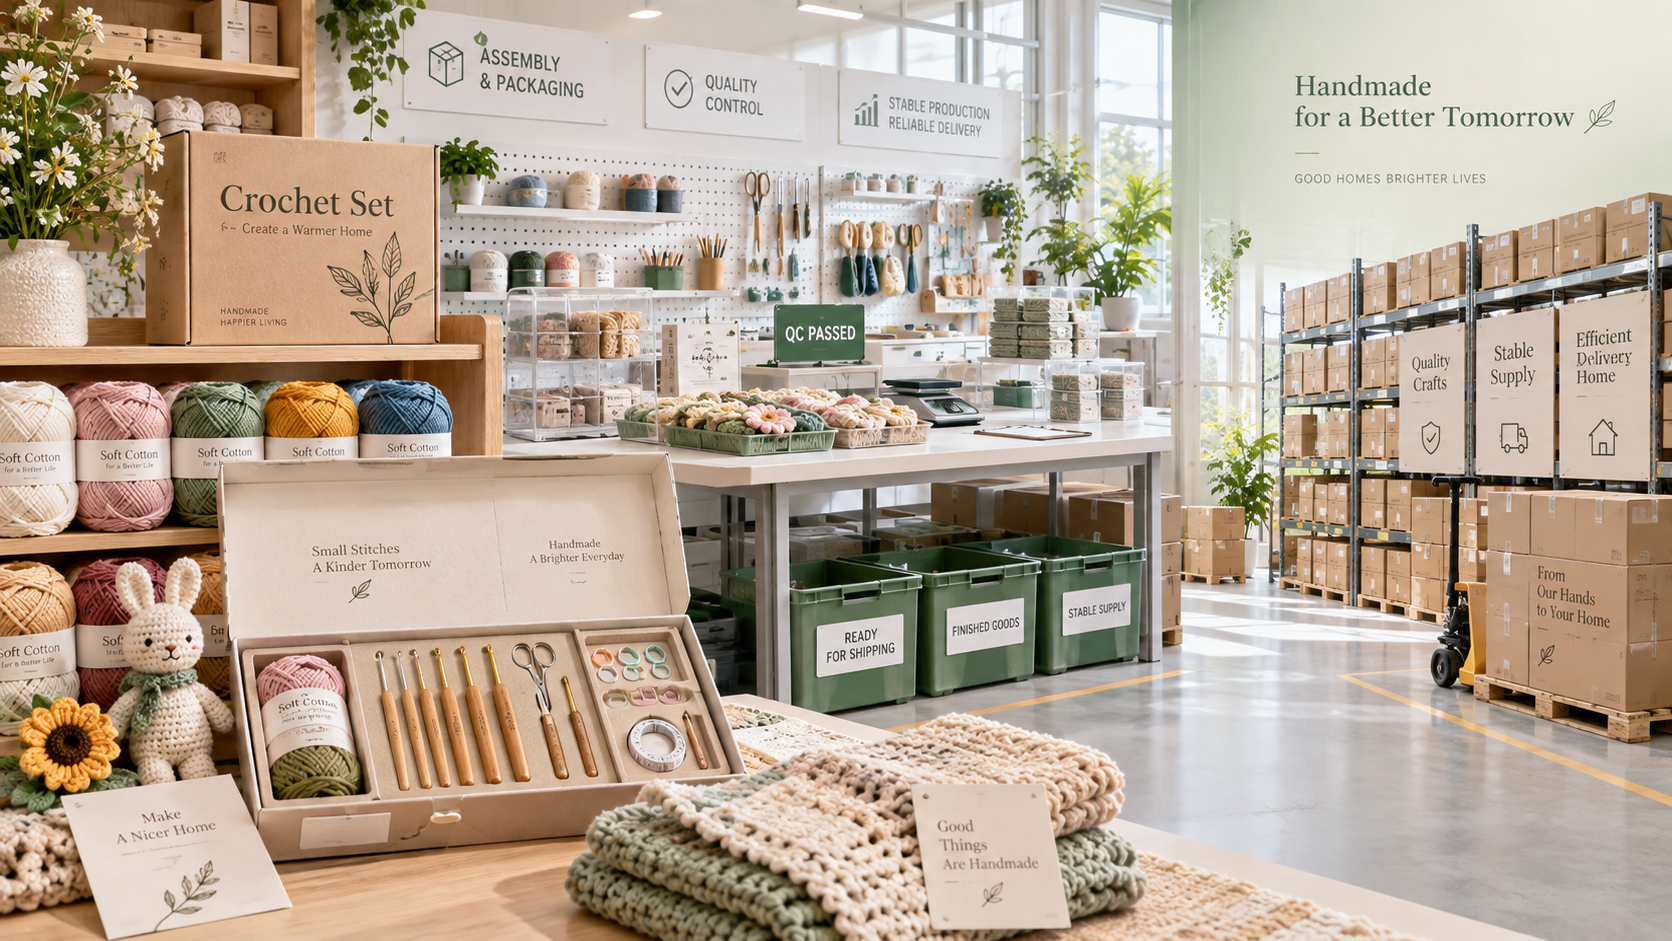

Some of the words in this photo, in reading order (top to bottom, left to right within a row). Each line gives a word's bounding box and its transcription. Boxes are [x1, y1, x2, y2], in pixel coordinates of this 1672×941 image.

[480, 48, 561, 72] ASSEMBLY
[480, 73, 491, 90] &
[497, 74, 584, 98] PACKAGING
[705, 74, 758, 94] QUALITY
[1295, 74, 1431, 97] Handmade
[705, 97, 764, 116] CONTROL
[888, 97, 926, 113] STABLE
[929, 100, 991, 121] PRODUCTION
[1295, 105, 1331, 127] for
[1338, 111, 1351, 127] a
[1360, 106, 1435, 127] Better
[1442, 106, 1575, 127] Tomorrow
[888, 116, 935, 133] RELIABLE
[938, 121, 982, 138] DELIVERY
[1294, 173, 1332, 184] GOOD
[1336, 173, 1381, 184] HOMES
[1386, 173, 1448, 184] BRIGHTER
[1453, 173, 1486, 184] LIVES
[220, 184, 341, 216] Crochet
[350, 190, 395, 217] Set
[242, 223, 279, 235] Create
[282, 226, 289, 235] a
[292, 224, 337, 237] Warmer
[340, 226, 373, 237] Home
[220, 307, 269, 316] HANDMADE
[220, 318, 257, 327] HAPPIER
[259, 318, 287, 327] LIVING
[785, 326, 804, 343] QC
[808, 325, 856, 341] PASSED
[1576, 328, 1632, 348] Efficient
[1494, 342, 1534, 361] Stable
[1576, 350, 1632, 367] Delivery
[1411, 353, 1451, 373] Quality
[1413, 375, 1447, 392] Crafts
[1490, 365, 1536, 388] Supply
[1576, 368, 1616, 384] Home
[100, 449, 122, 461] Soft
[125, 449, 159, 460] Cotton
[197, 447, 218, 458] Soft
[221, 447, 253, 457] Cotton
[292, 447, 312, 457] Soft
[315, 447, 345, 457] Cotton
[387, 443, 407, 453] Soft
[409, 443, 439, 452] Cotton
[0, 452, 21, 464] Soft
[24, 452, 61, 463] Cotton
[312, 544, 347, 557] Small
[351, 543, 400, 556] Stitches
[549, 538, 601, 550] Handmade
[312, 561, 322, 573] A
[325, 560, 367, 573] Kinder
[370, 558, 432, 571] Tomorrow
[529, 554, 538, 564] A
[540, 553, 580, 565] Brighter
[581, 551, 625, 564] Everyday
[1537, 565, 1566, 583] From
[1536, 584, 1557, 600] Our
[1560, 587, 1596, 606] Hands
[1068, 604, 1097, 619] STABLE
[1098, 601, 1127, 615] SUPPLY
[1536, 604, 1547, 617] to
[1549, 605, 1574, 622] Your
[1577, 609, 1611, 628] Home
[952, 621, 990, 637] FINISHED
[993, 616, 1020, 632] GOODS
[844, 628, 878, 645] READY
[24, 644, 61, 656] Cotton
[826, 650, 846, 664] FOR
[849, 641, 896, 661] SHIPPING
[141, 809, 181, 824] Make
[116, 833, 128, 845] A
[131, 827, 170, 844] Nicer
[173, 821, 216, 839] Home
[937, 819, 974, 832] Good
[939, 838, 988, 854] Things
[943, 858, 966, 870] Are
[969, 857, 1039, 870] Handmade
